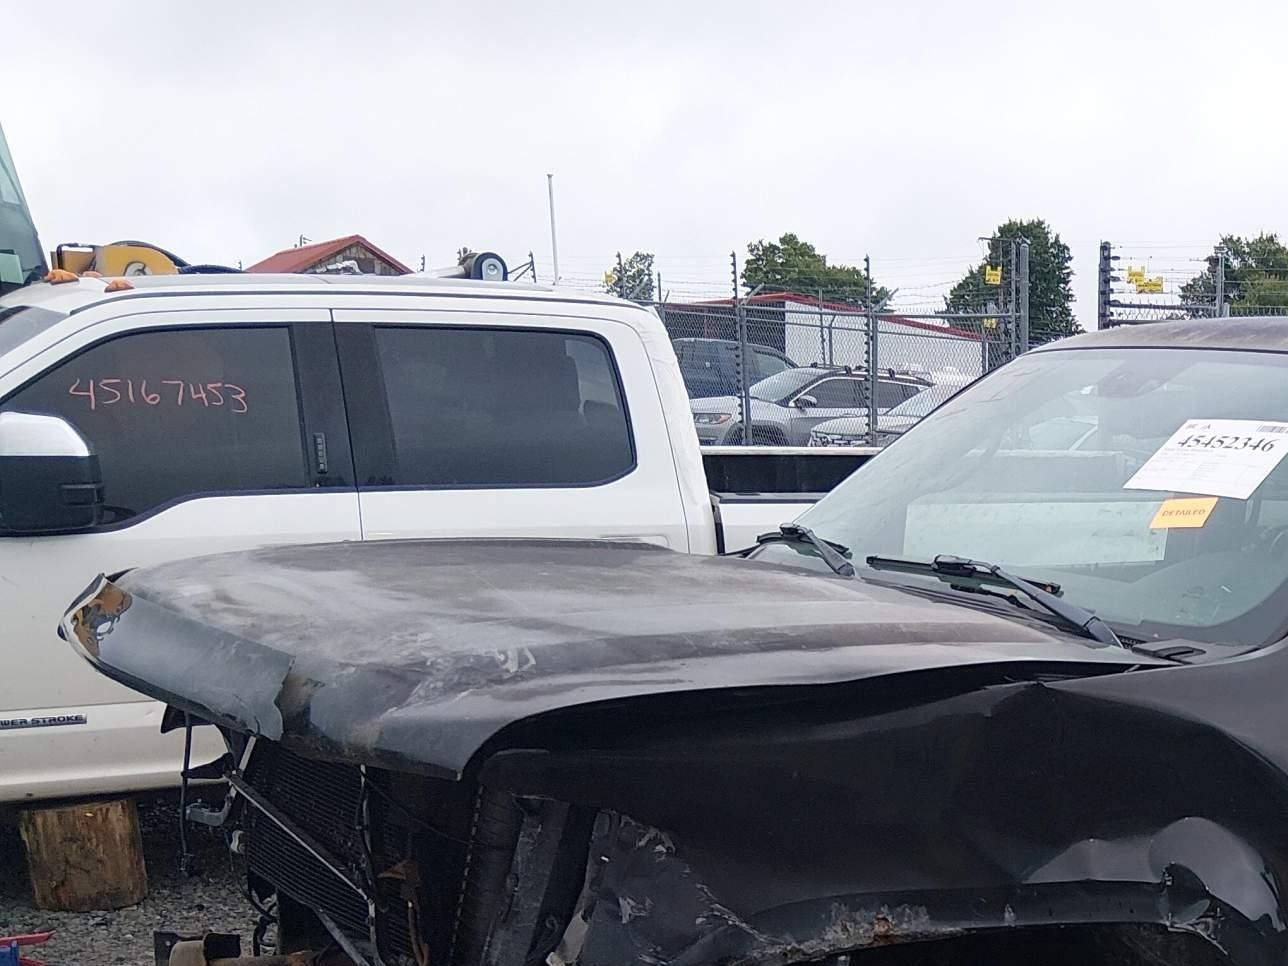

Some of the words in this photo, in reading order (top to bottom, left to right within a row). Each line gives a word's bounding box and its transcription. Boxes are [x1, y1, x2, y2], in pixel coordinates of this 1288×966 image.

[69, 378, 248, 413] 45167453
[1177, 434, 1280, 452] 45452346
[1162, 509, 1206, 517] DETAILED
[31, 714, 84, 726] STROKE
